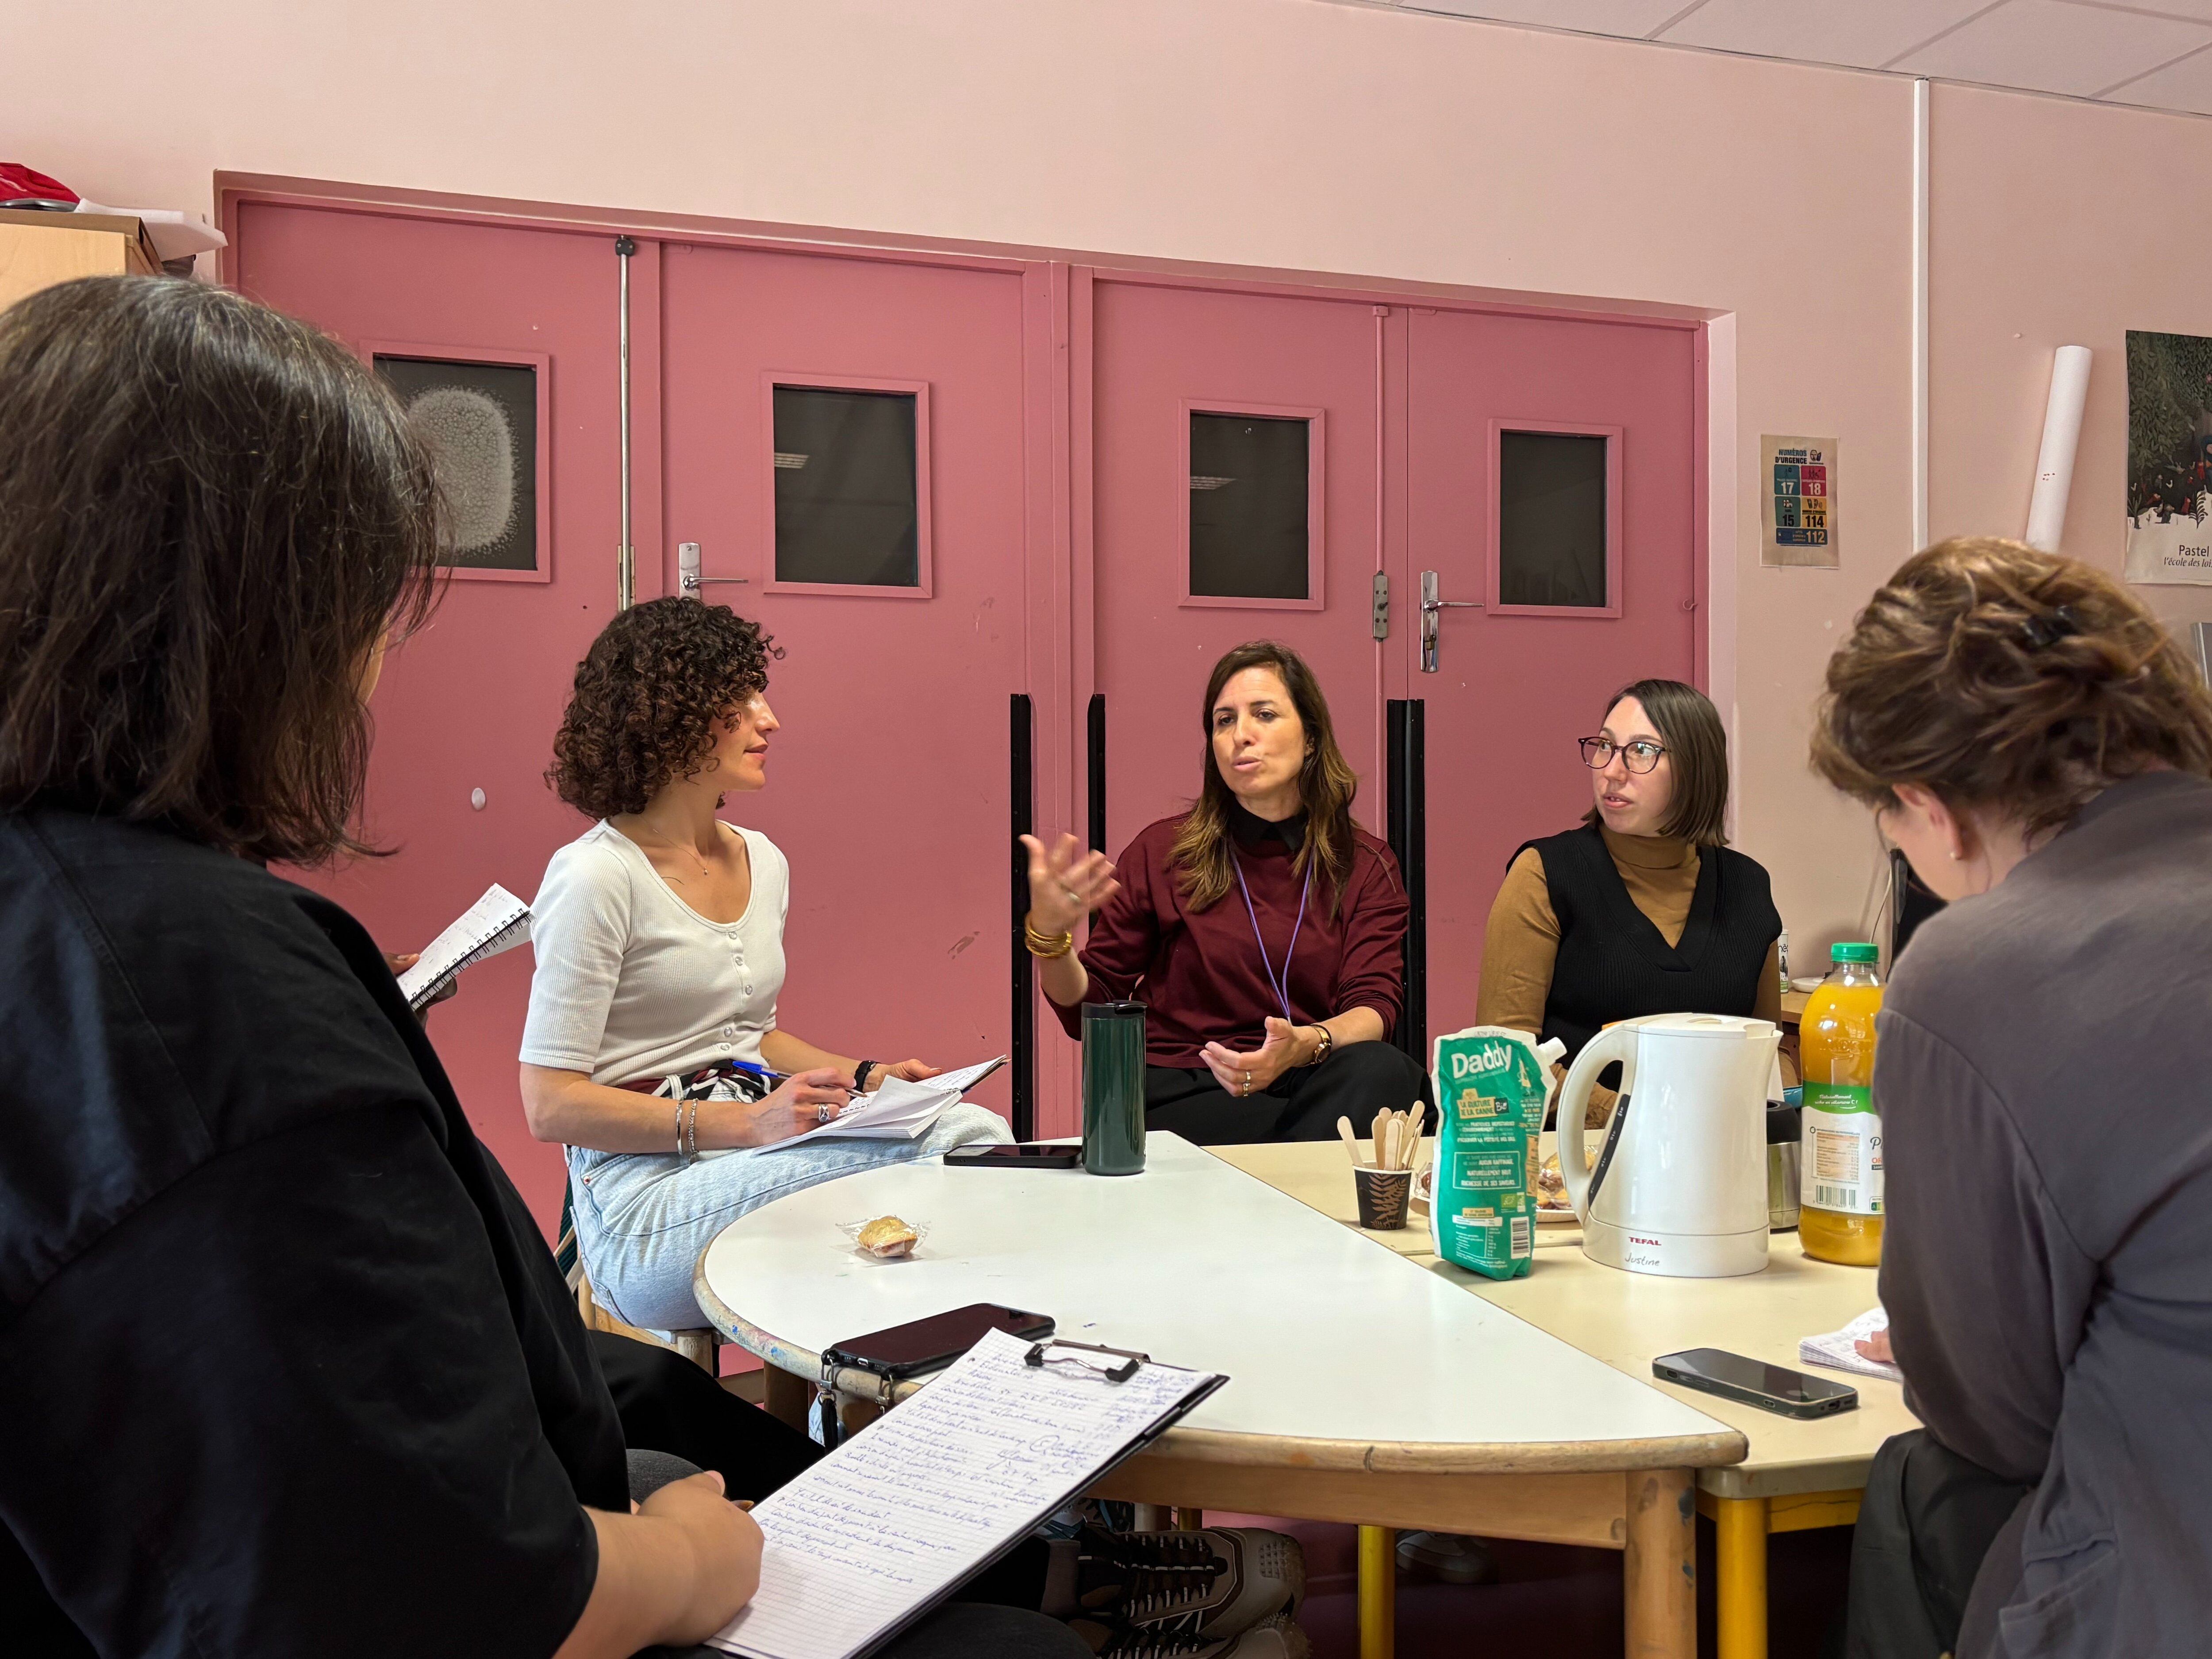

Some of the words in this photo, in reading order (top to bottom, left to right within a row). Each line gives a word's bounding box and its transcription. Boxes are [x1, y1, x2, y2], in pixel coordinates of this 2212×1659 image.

[1781, 482, 1794, 494] 17
[1809, 483, 1821, 495] 18
[1782, 514, 1794, 526] 15
[1805, 515, 1824, 528] 114
[1806, 531, 1825, 543] 112
[2179, 545, 2209, 557] Pastel
[2164, 557, 2187, 566] l'école
[2188, 558, 2200, 567] des
[2202, 559, 2212, 568] loi
[1451, 1040, 1512, 1079] Daddy
[1628, 1237, 1662, 1245] TEFAL
[1624, 1252, 1660, 1266] Justine
